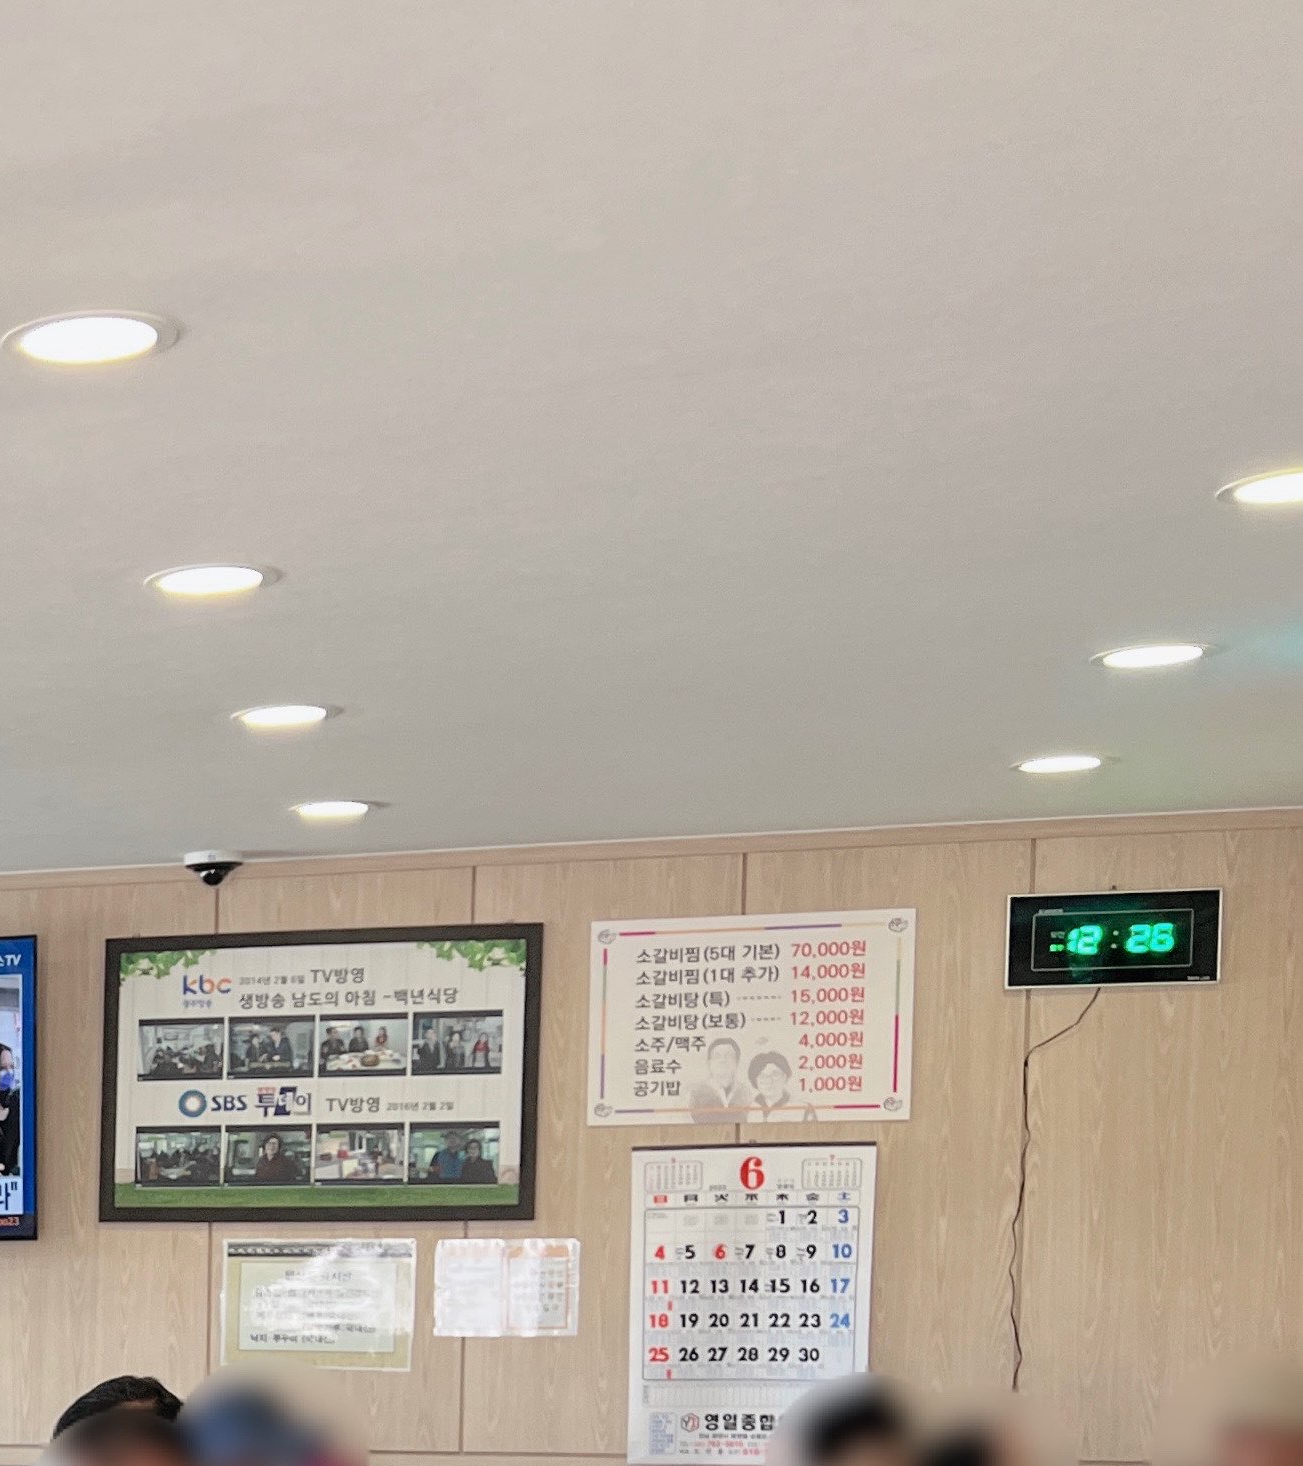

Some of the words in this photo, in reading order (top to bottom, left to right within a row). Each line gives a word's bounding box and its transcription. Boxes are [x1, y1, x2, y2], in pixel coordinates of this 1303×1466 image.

[742, 943, 781, 961] 기본)
[791, 940, 867, 958] 70,000원
[310, 967, 365, 984] TV방영
[741, 966, 779, 983] 추가)
[791, 962, 866, 980] 14,000원
[182, 974, 232, 996] kbc
[239, 993, 285, 1009] 생방송
[291, 992, 338, 1007] 남도의
[345, 990, 376, 1006] 아침
[790, 986, 866, 1003] 15,000원
[790, 1009, 865, 1026] 12,000원
[634, 1035, 707, 1052] 소주/맥주
[798, 1031, 864, 1048] 4,000원
[634, 1059, 682, 1075] 음료수
[798, 1053, 864, 1071] 2,000원
[633, 1080, 681, 1097] 공기밥
[799, 1076, 863, 1093] 1,000원
[211, 1095, 247, 1112] SBS
[326, 1097, 380, 1113] TV방영
[739, 1156, 765, 1190] 6
[778, 1210, 786, 1224] 1
[807, 1209, 817, 1224] 2
[838, 1209, 849, 1224] 3
[655, 1246, 665, 1260] 4
[685, 1245, 696, 1259] 5
[713, 1244, 726, 1259] 6
[745, 1245, 755, 1259] 7
[776, 1244, 786, 1259] 8
[806, 1244, 817, 1258] 9
[832, 1243, 852, 1259] 10
[651, 1280, 668, 1294] 11
[680, 1280, 699, 1294] 12
[710, 1280, 729, 1294] 13
[740, 1279, 759, 1293] 14
[770, 1279, 790, 1293] 15
[800, 1278, 819, 1293] 16
[830, 1278, 849, 1293] 17
[649, 1314, 668, 1328] 18
[680, 1314, 699, 1329] 19
[709, 1314, 729, 1328] 20
[740, 1313, 759, 1327] 21
[769, 1313, 790, 1327] 22
[799, 1312, 821, 1327] 23
[830, 1313, 850, 1328] 24
[649, 1348, 669, 1362] 25
[679, 1348, 699, 1362] 26
[708, 1348, 728, 1362] 27
[737, 1348, 758, 1362] 28
[768, 1348, 789, 1362] 29
[799, 1348, 819, 1362] 30
